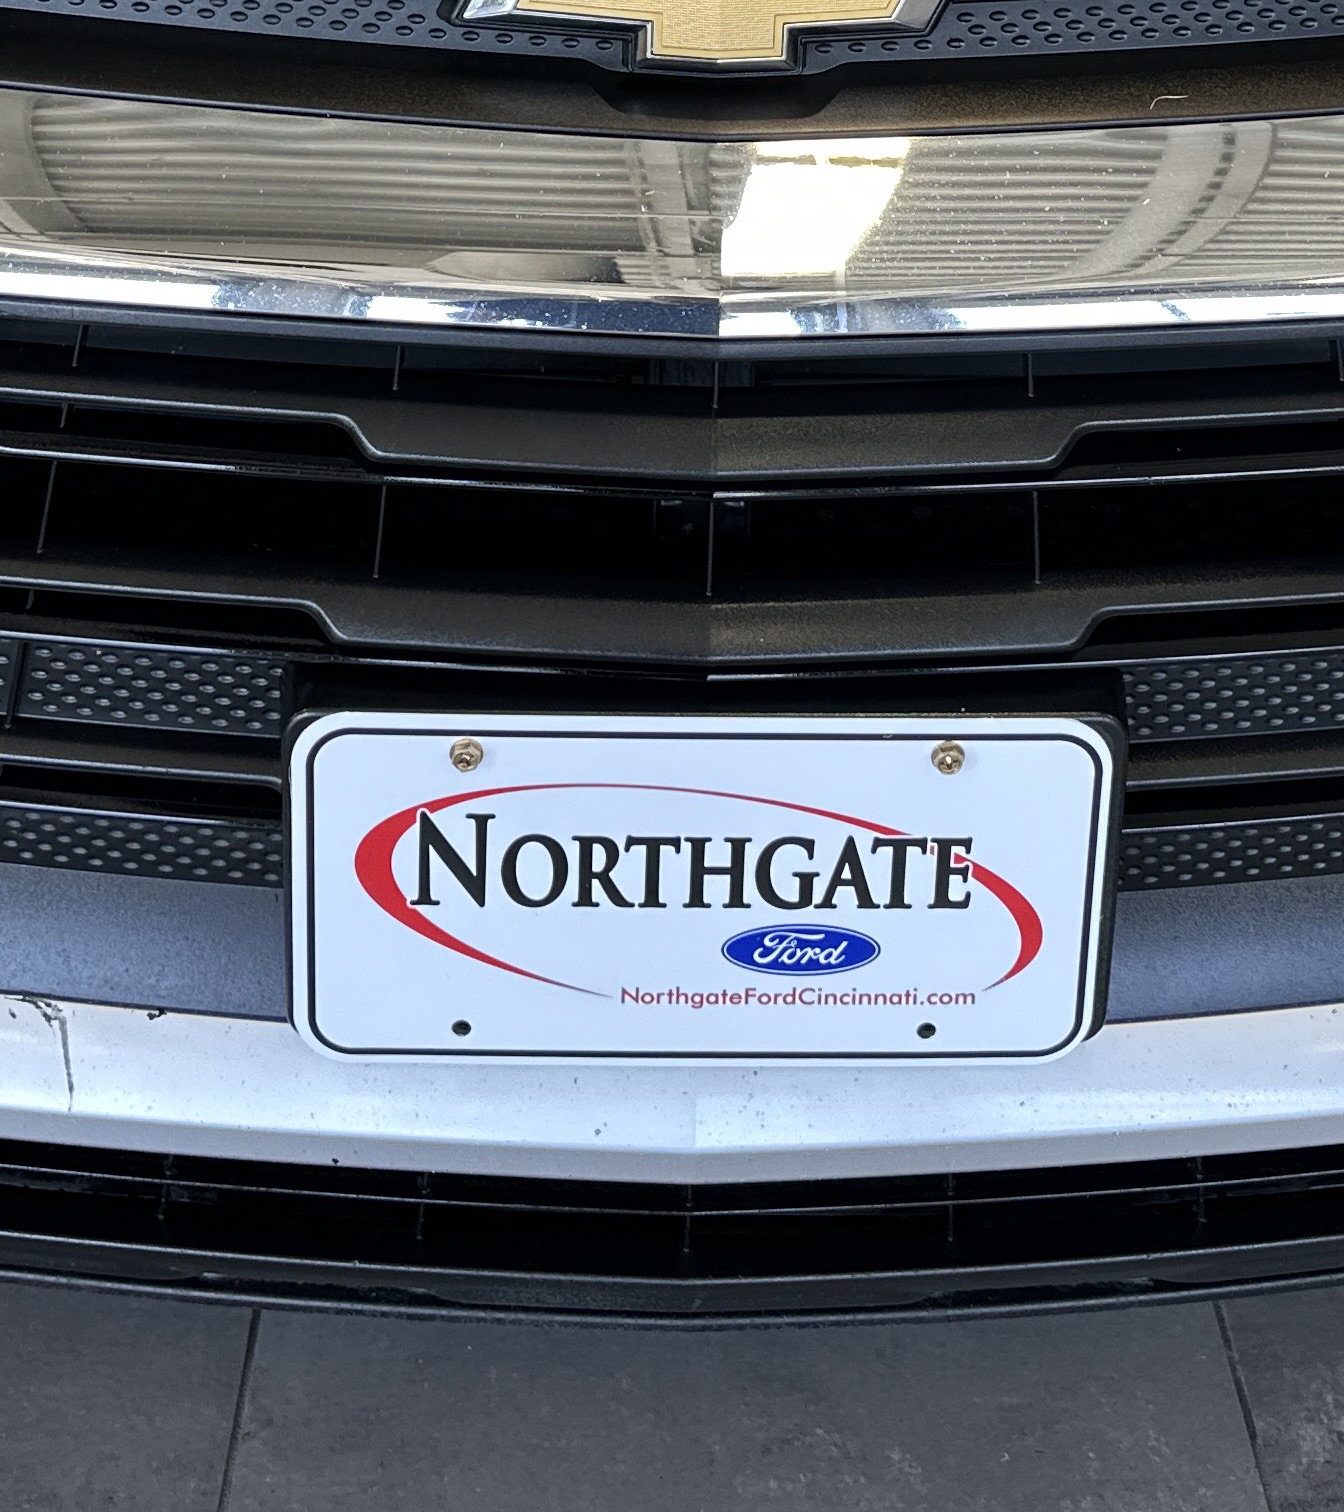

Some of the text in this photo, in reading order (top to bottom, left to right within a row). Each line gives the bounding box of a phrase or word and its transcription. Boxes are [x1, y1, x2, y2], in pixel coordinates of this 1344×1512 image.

[409, 810, 973, 910] NORTHGATE
[753, 931, 849, 965] Ford
[620, 987, 976, 1009] NorthgateFordCincinnati.com
